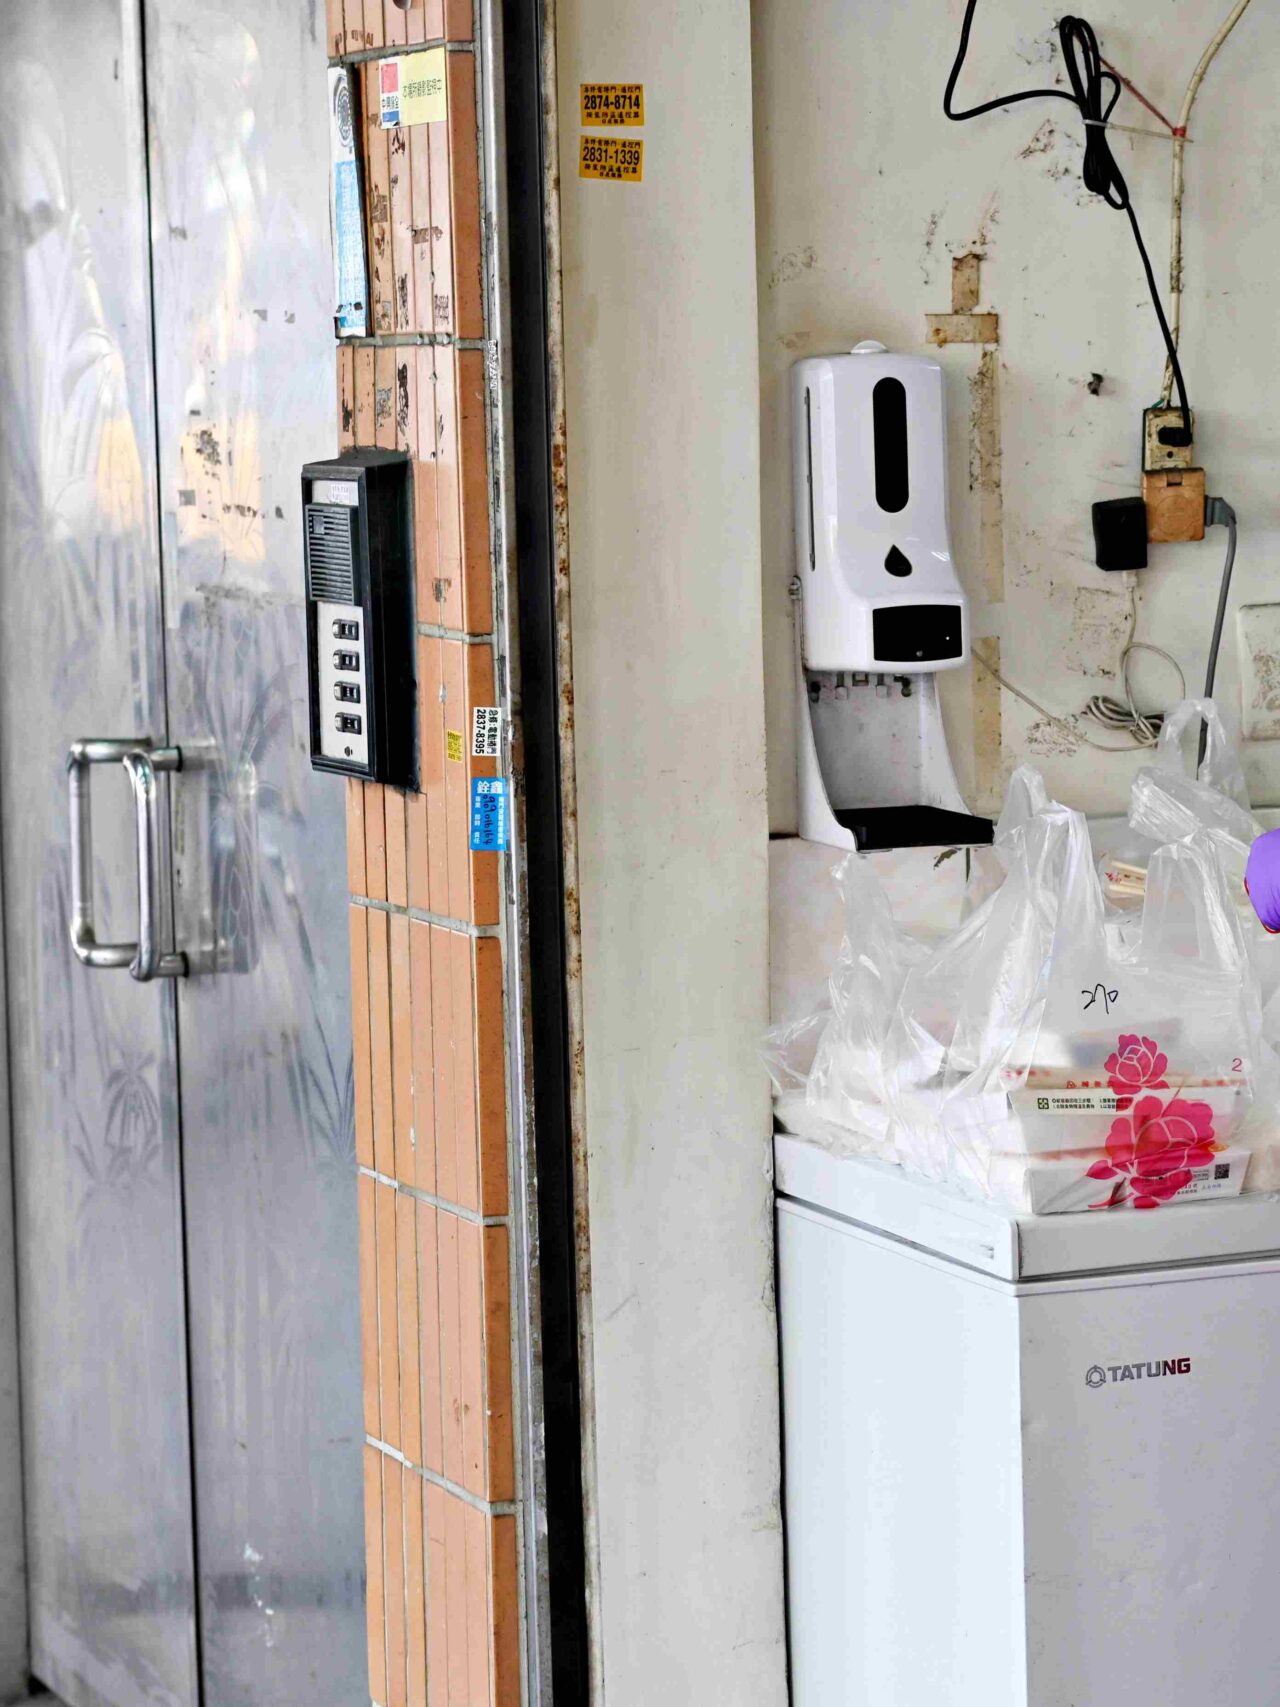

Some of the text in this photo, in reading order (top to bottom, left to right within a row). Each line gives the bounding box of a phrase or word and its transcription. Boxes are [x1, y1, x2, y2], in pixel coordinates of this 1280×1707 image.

[584, 94, 640, 110] 2874-8714
[582, 146, 640, 166] 2831-1339
[475, 708, 487, 755] 2837-8395
[1108, 1357, 1191, 1383] TATUNG
